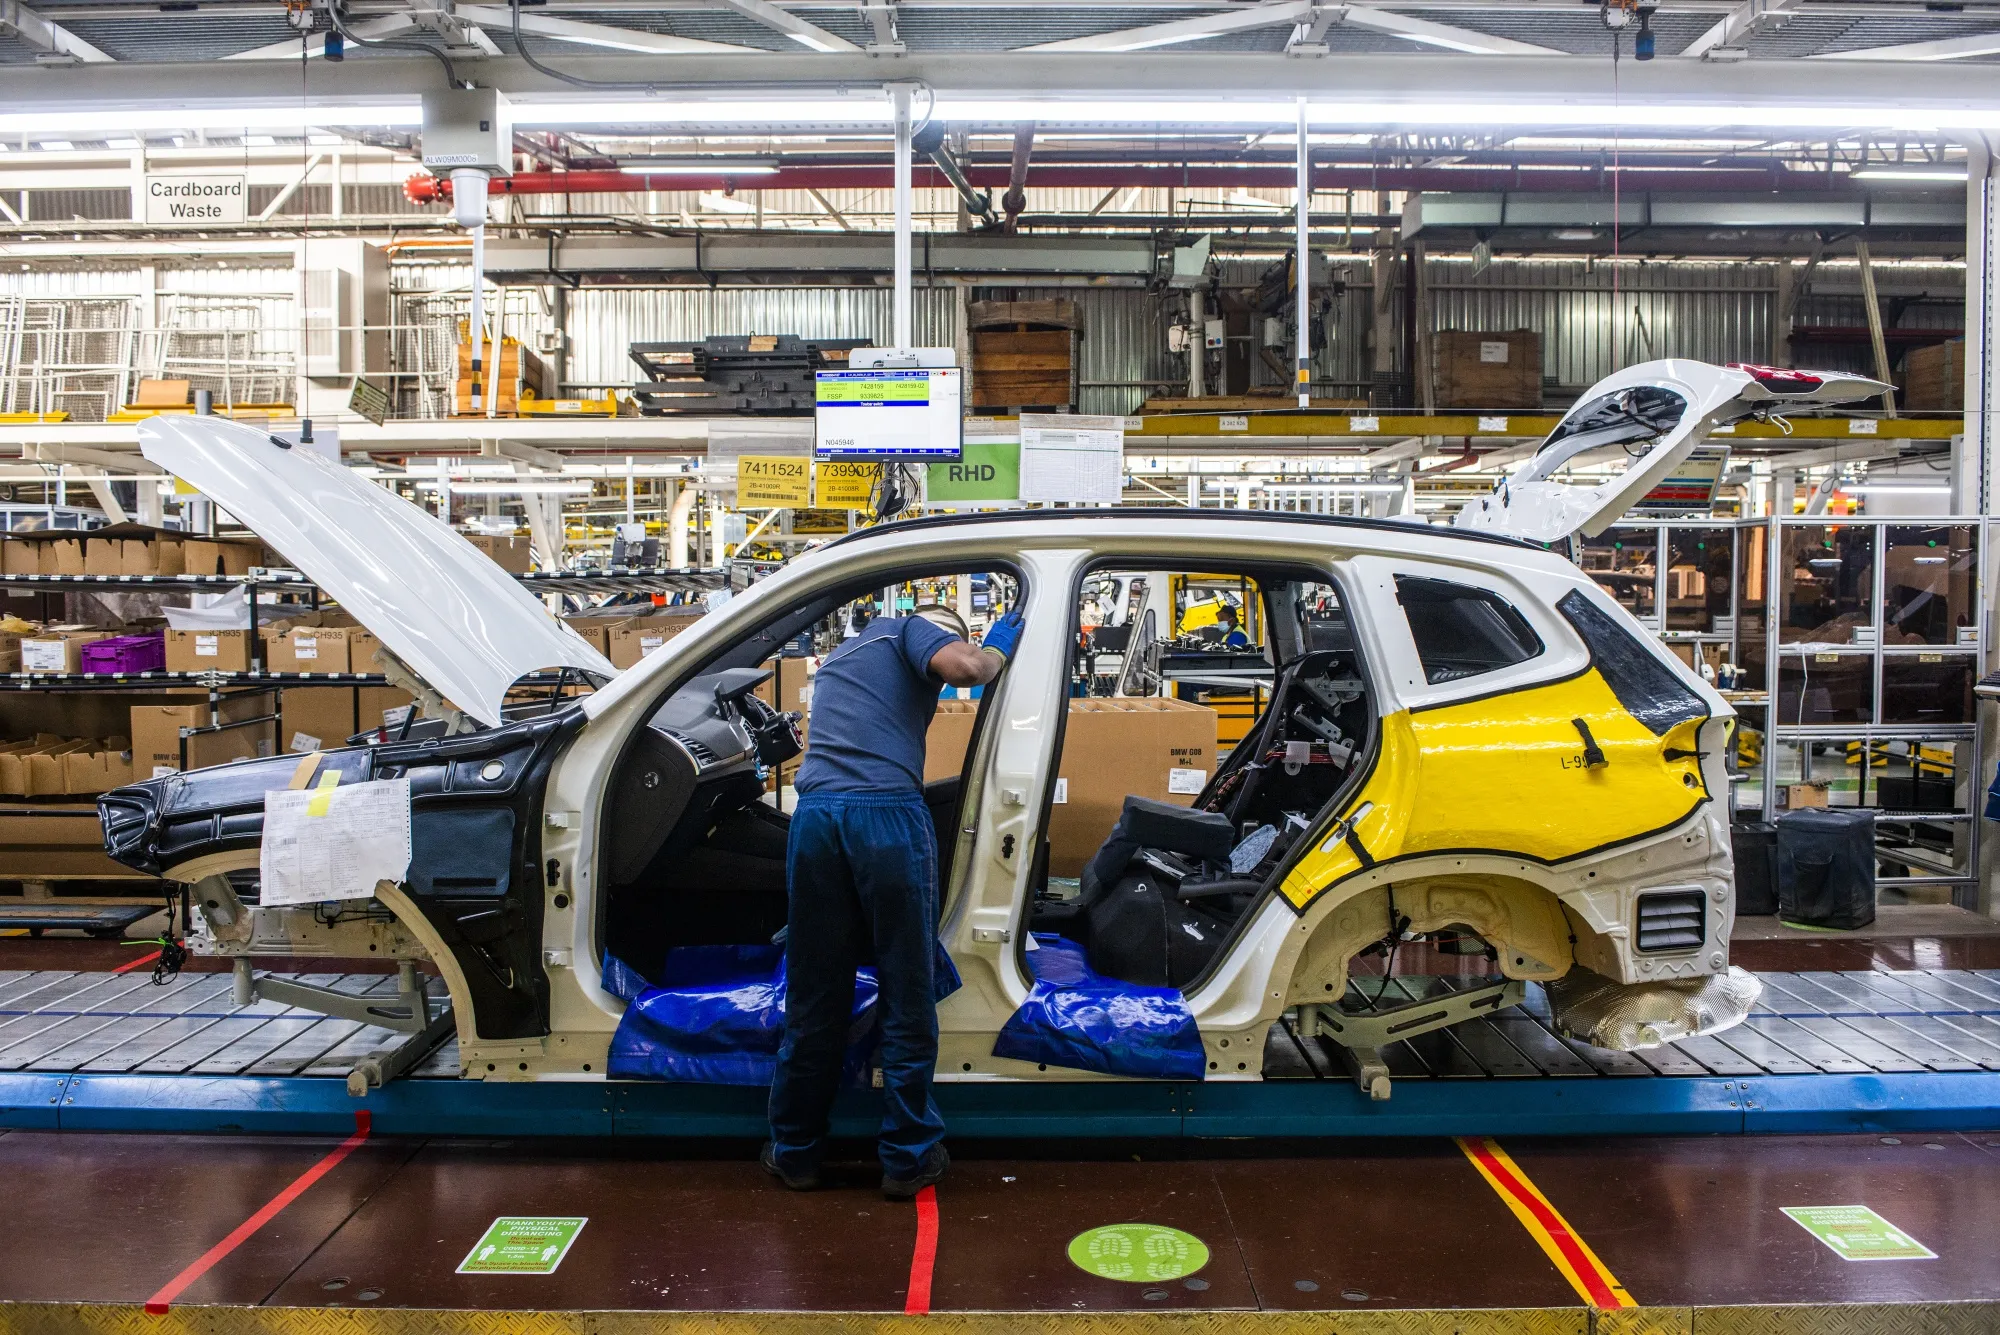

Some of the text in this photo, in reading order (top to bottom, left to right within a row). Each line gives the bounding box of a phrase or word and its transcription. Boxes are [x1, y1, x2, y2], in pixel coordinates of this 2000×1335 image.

[150, 182, 242, 197] Cardboard
[170, 204, 222, 218] Waste
[744, 461, 804, 476] 7411524
[949, 464, 995, 481] RHD
